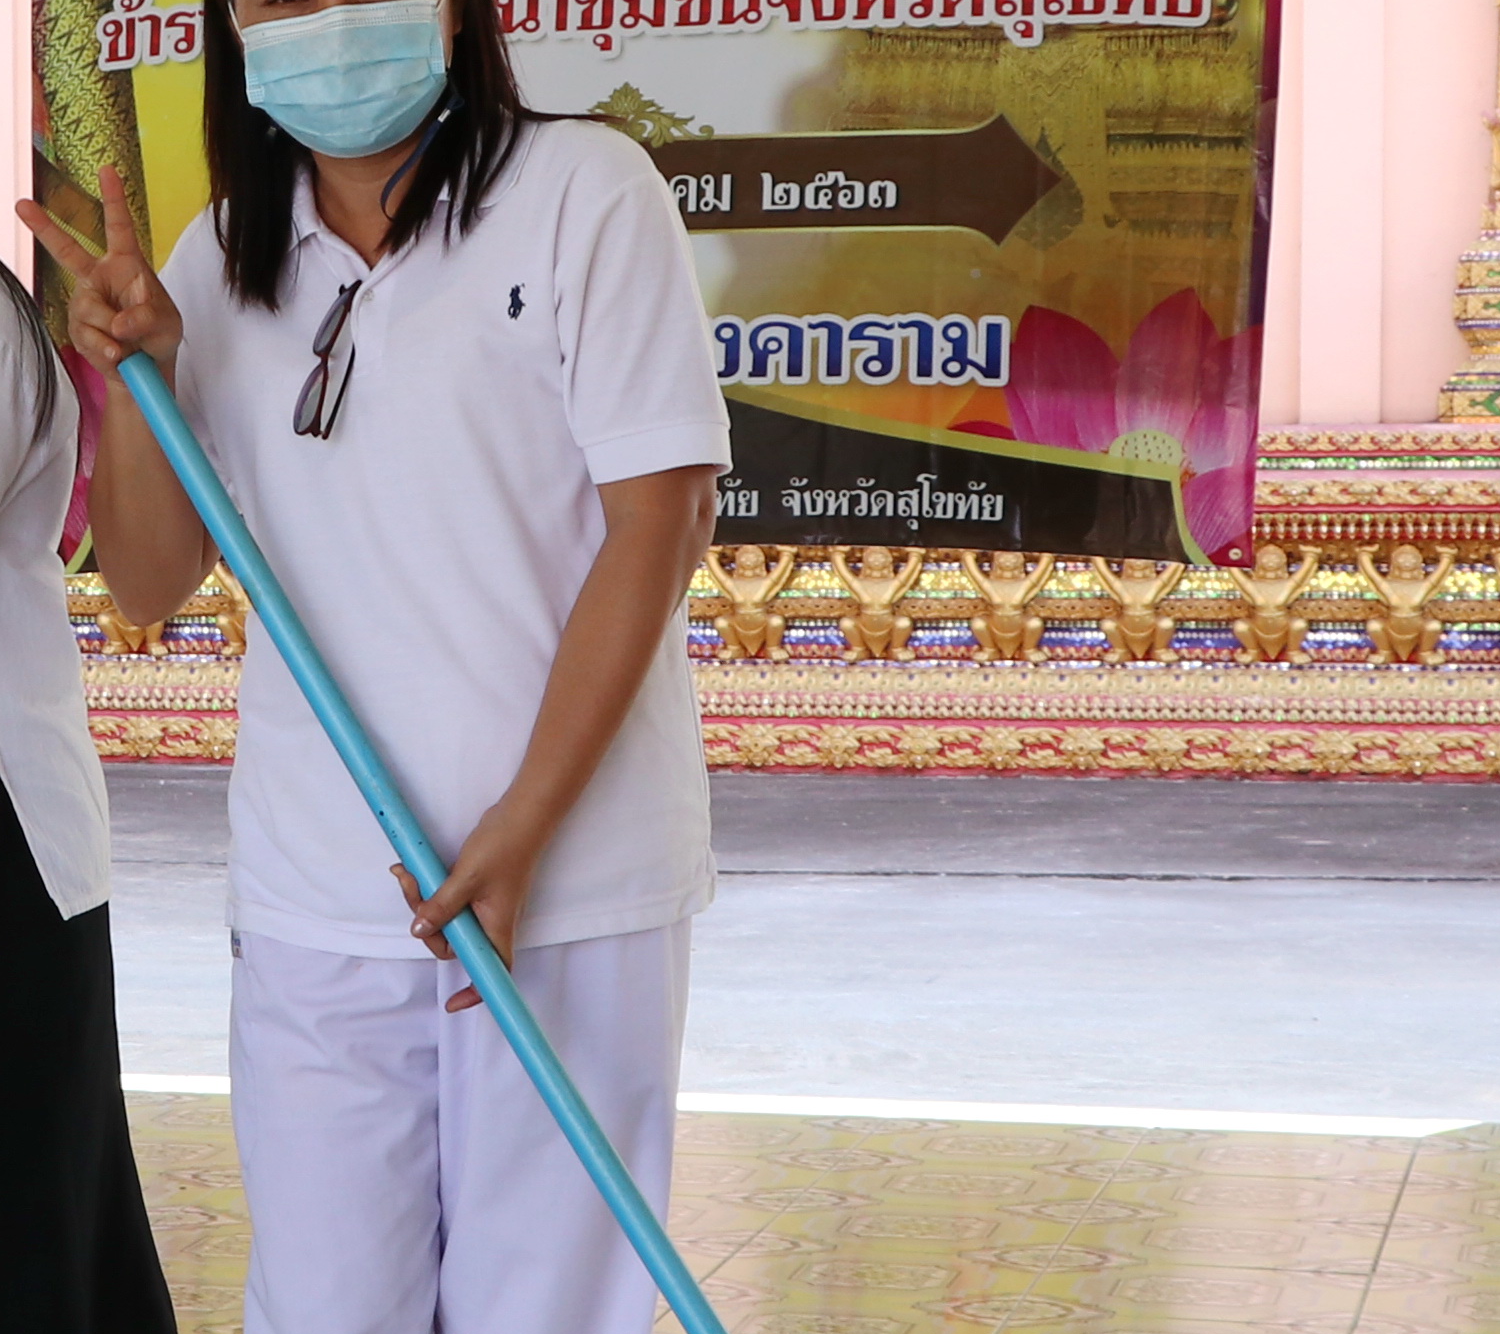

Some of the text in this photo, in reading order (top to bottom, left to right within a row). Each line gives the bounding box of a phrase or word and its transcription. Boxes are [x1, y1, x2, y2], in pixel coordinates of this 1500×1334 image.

[760, 171, 898, 211] ๒๕๖๓
[780, 473, 1004, 531] จังหวัดสุโขทัย
